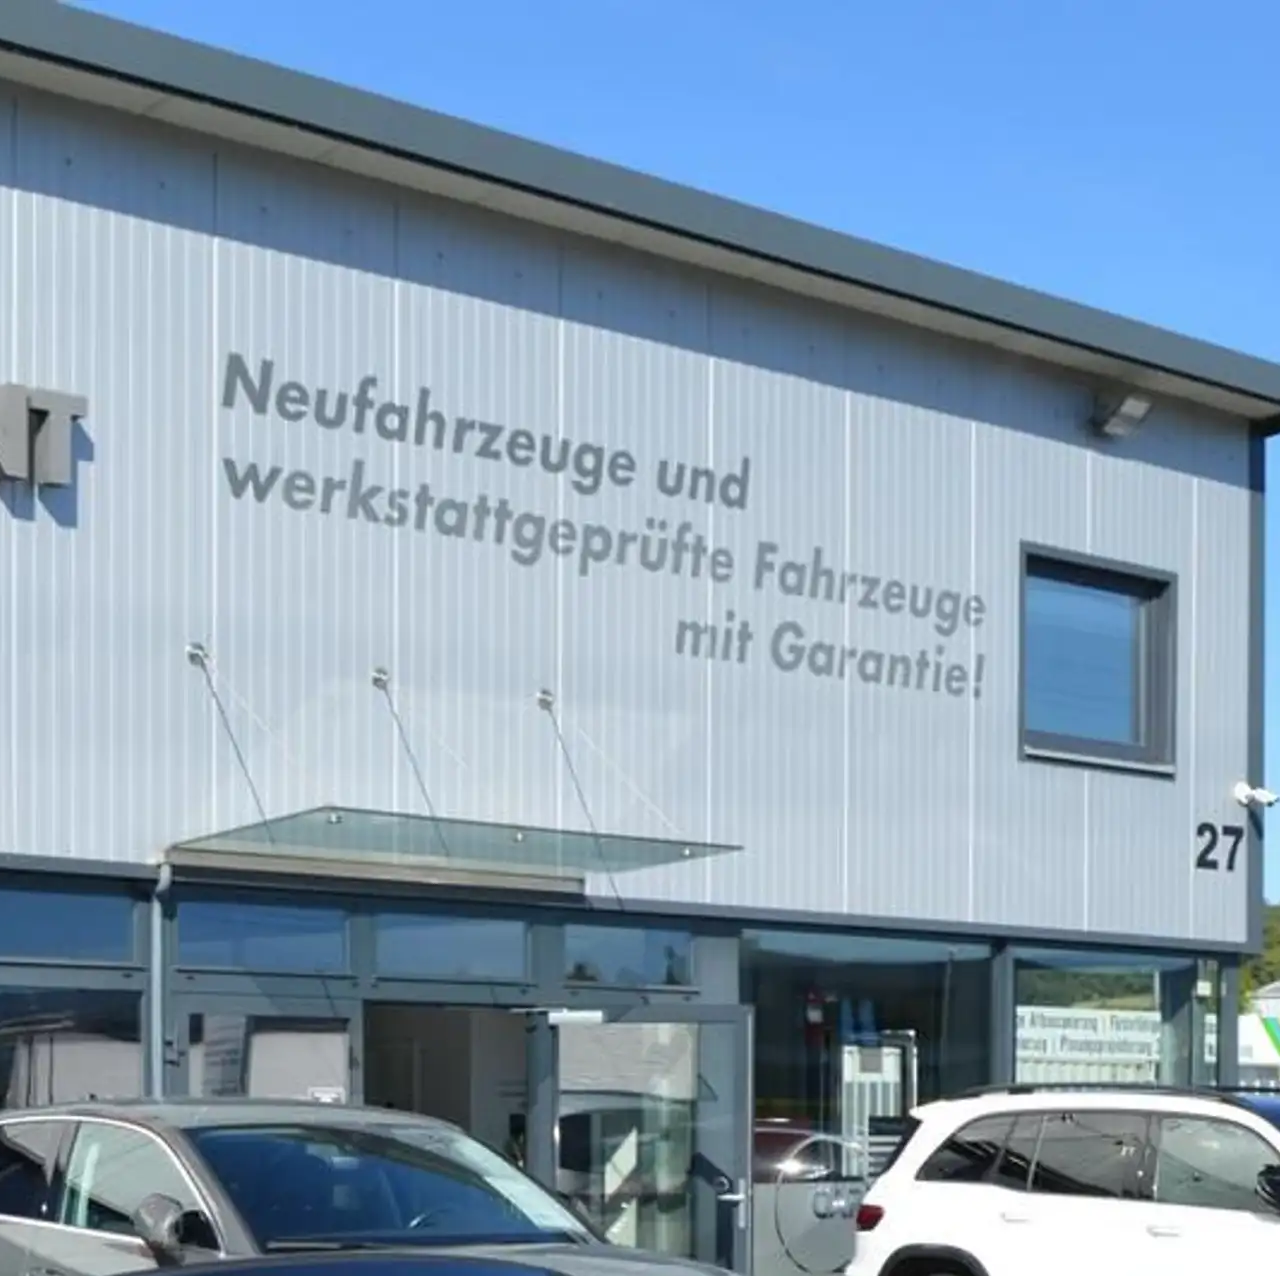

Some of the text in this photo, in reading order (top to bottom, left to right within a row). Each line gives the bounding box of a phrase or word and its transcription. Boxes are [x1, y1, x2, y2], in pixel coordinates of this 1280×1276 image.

[221, 352, 751, 511] Neufahrzeuge und
[222, 455, 988, 637] werkstattgeprüfte Fahrzeuge
[675, 611, 986, 699] mit Garantie!
[1195, 821, 1245, 872] 27
